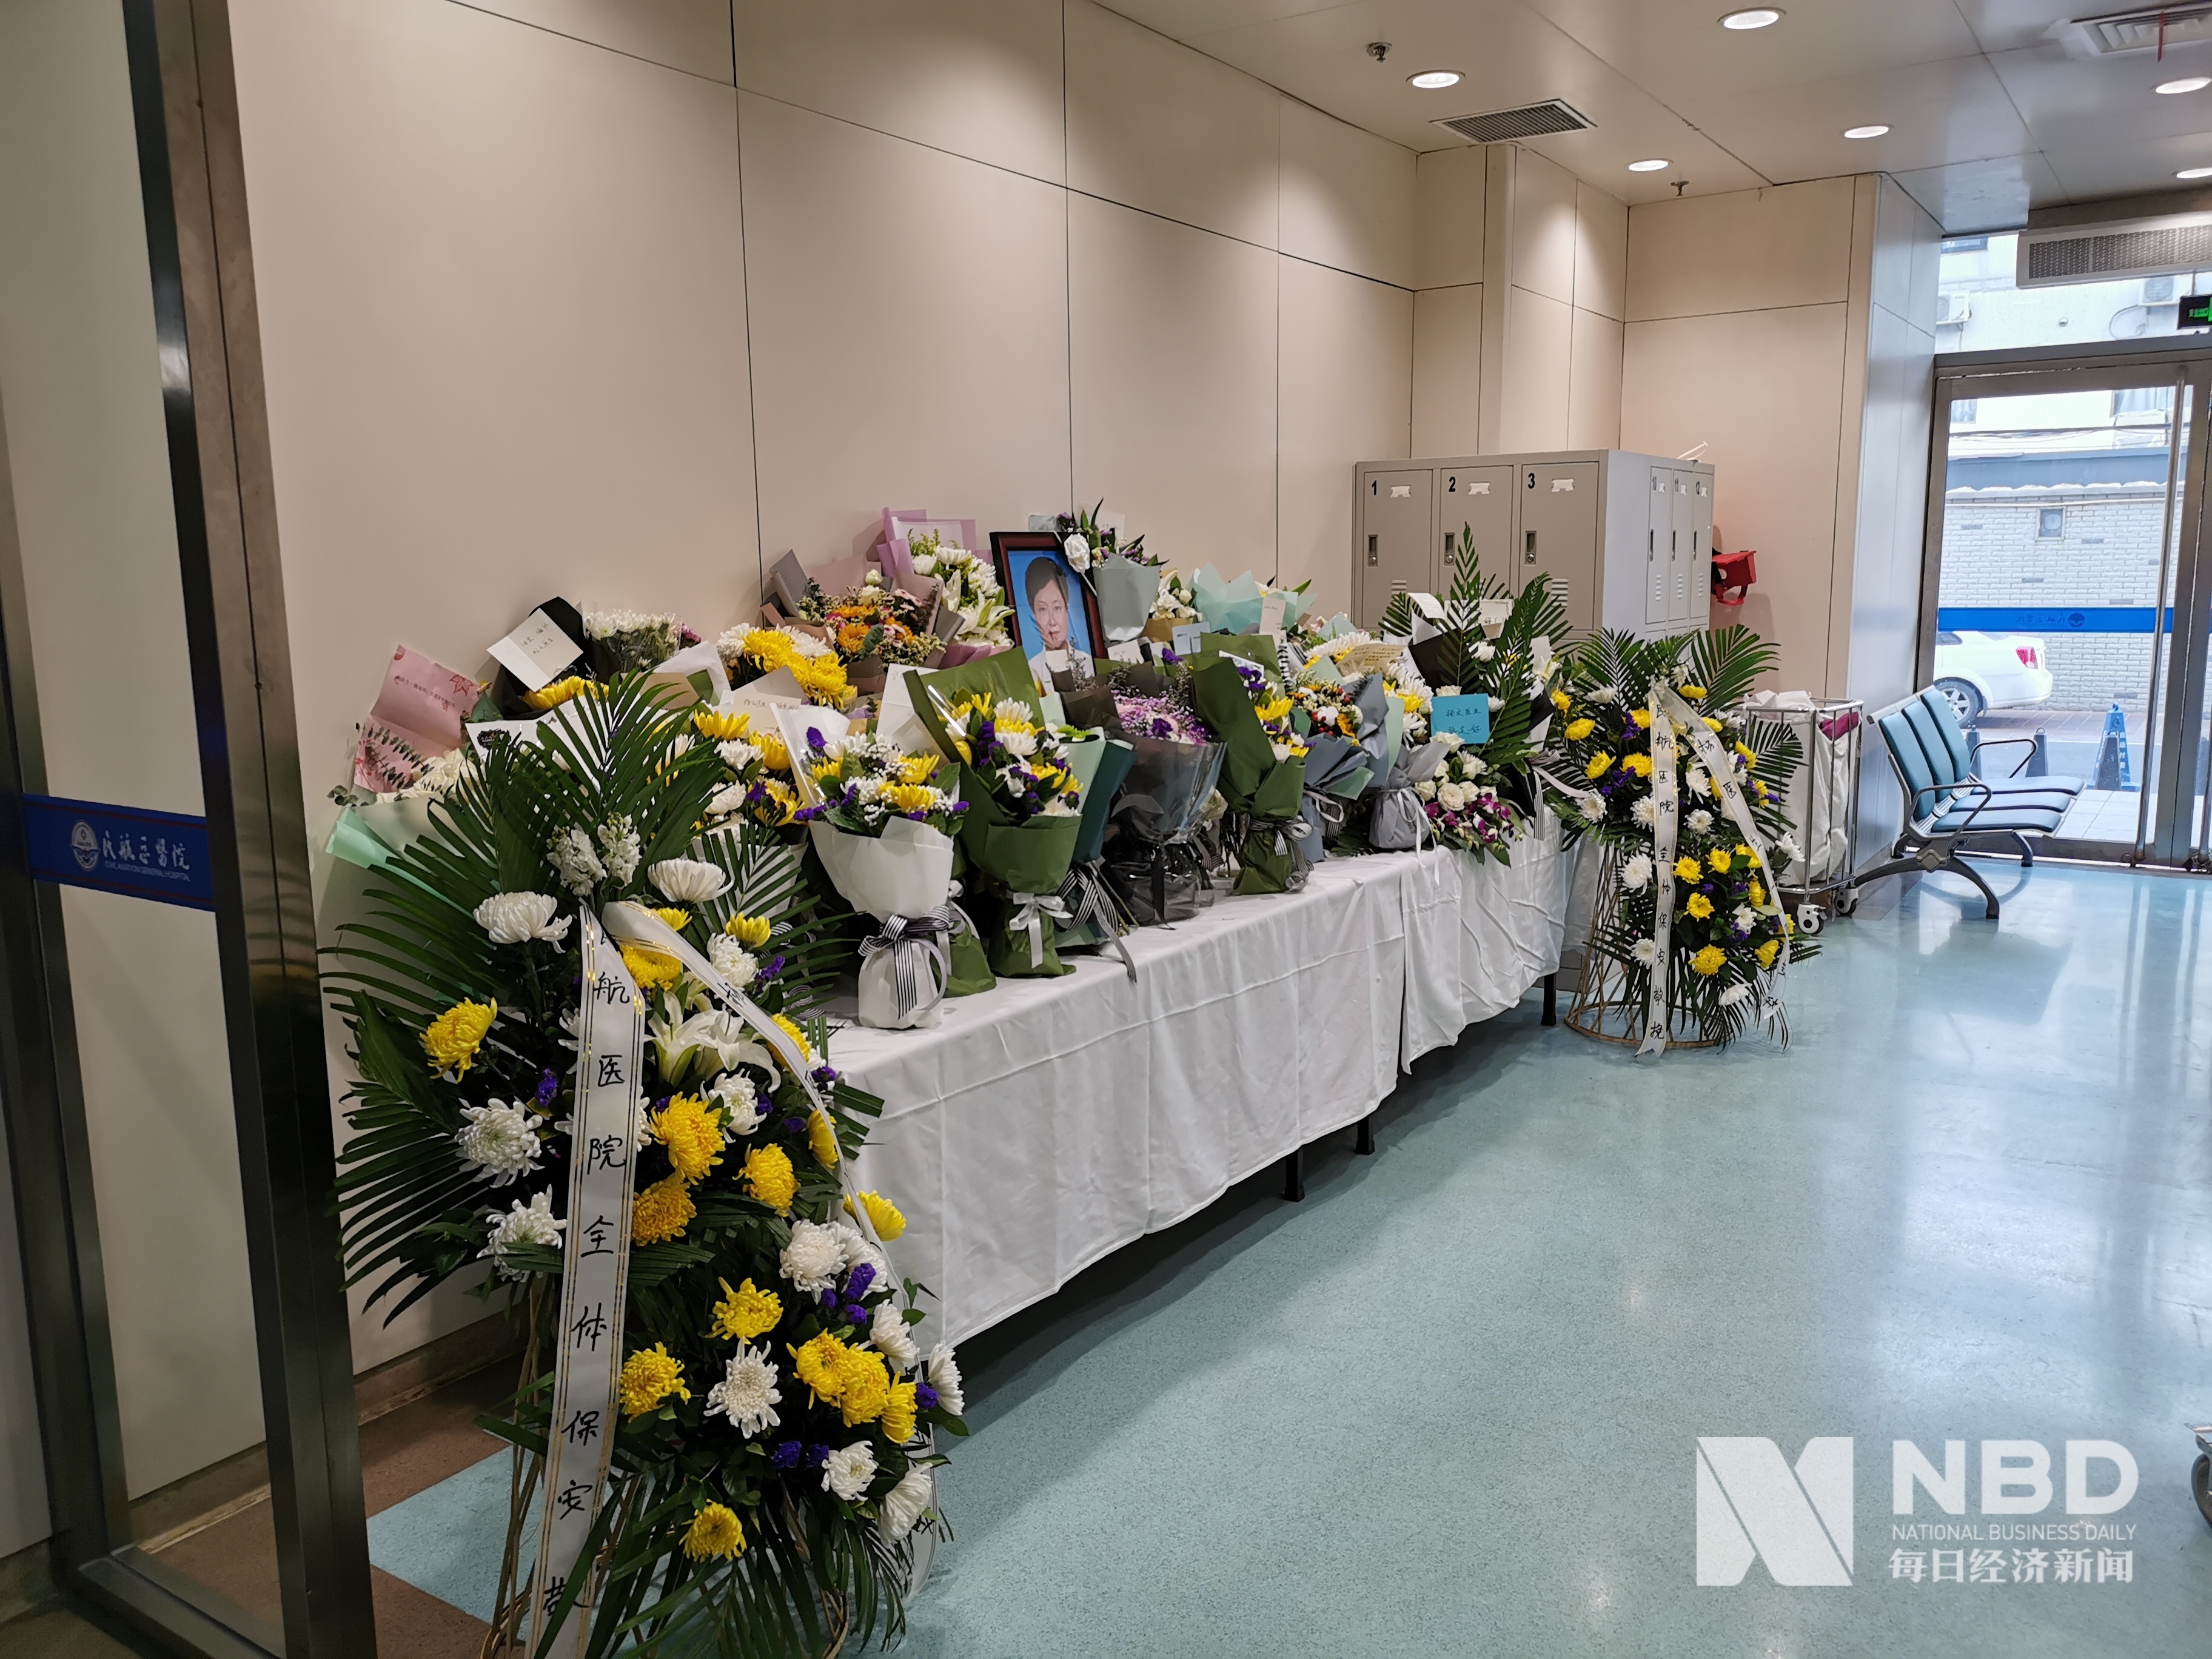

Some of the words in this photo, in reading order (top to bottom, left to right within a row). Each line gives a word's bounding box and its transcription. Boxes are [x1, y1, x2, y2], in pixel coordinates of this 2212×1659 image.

[1372, 480, 1377, 495] 1
[1449, 477, 1456, 492] 2
[1527, 473, 1535, 489] 3
